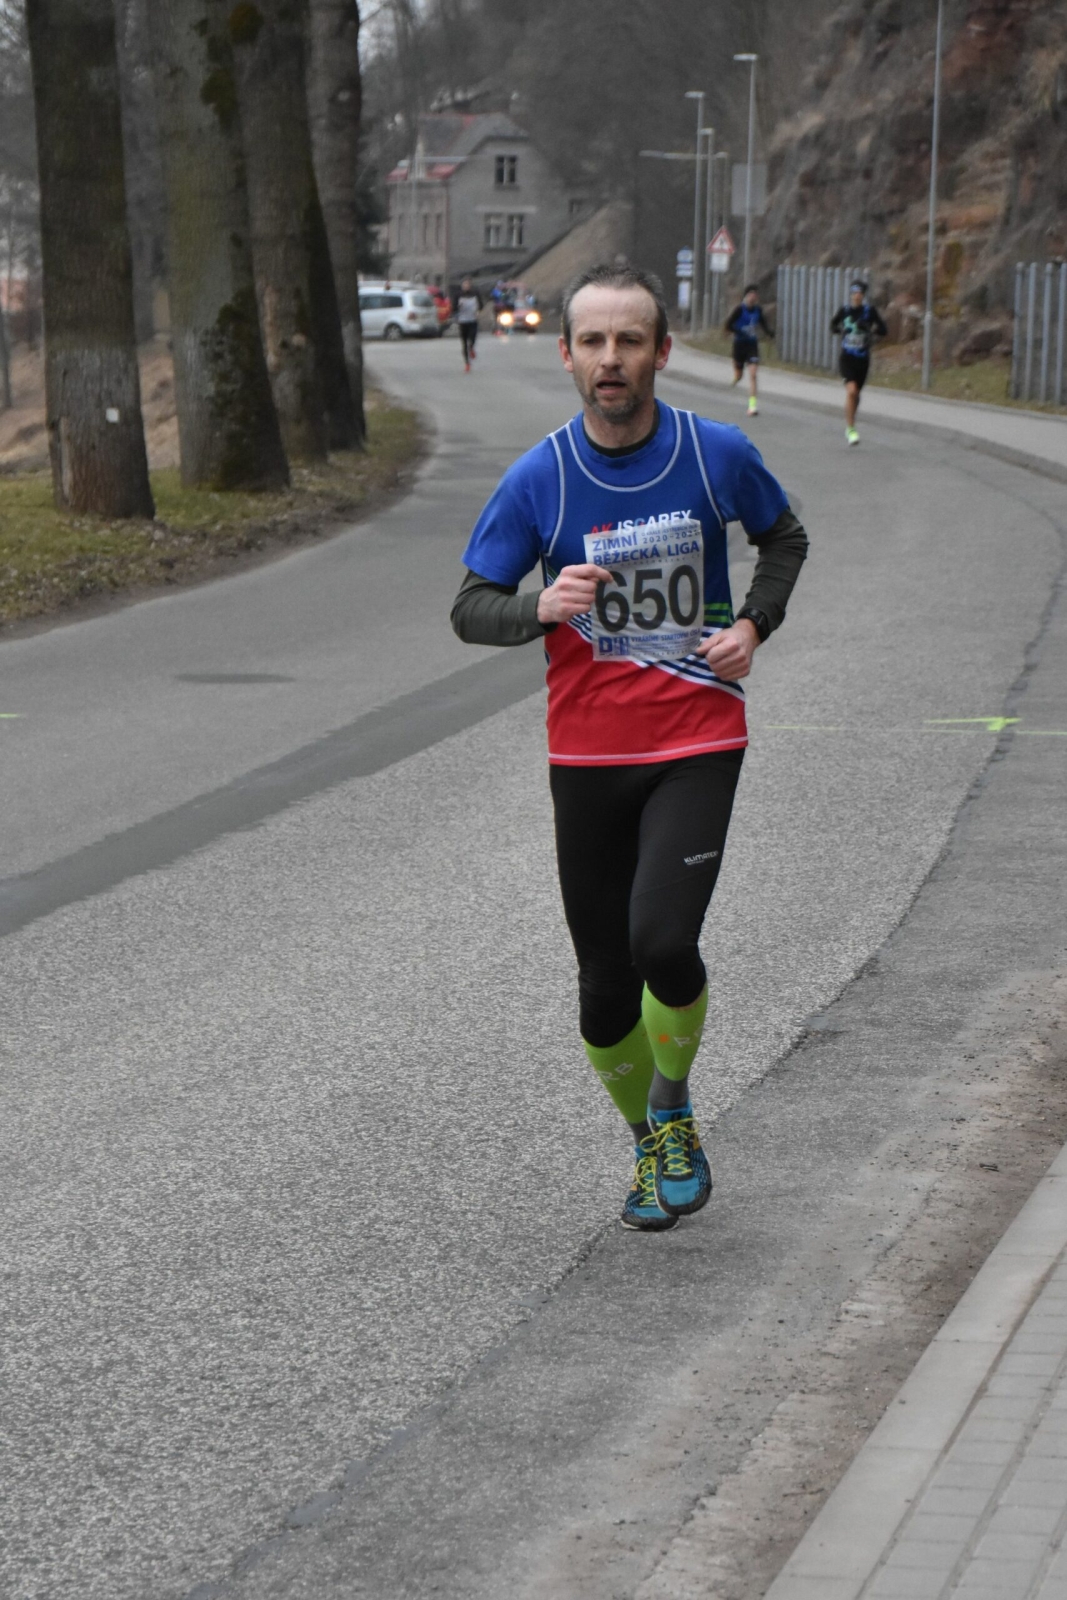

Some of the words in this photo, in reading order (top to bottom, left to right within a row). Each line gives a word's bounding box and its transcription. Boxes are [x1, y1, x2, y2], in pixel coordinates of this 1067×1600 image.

[592, 532, 638, 552] ZIMNÍ
[593, 545, 660, 566] BĚŽECKÁ
[667, 540, 700, 557] LIGA
[595, 564, 700, 633] 650
